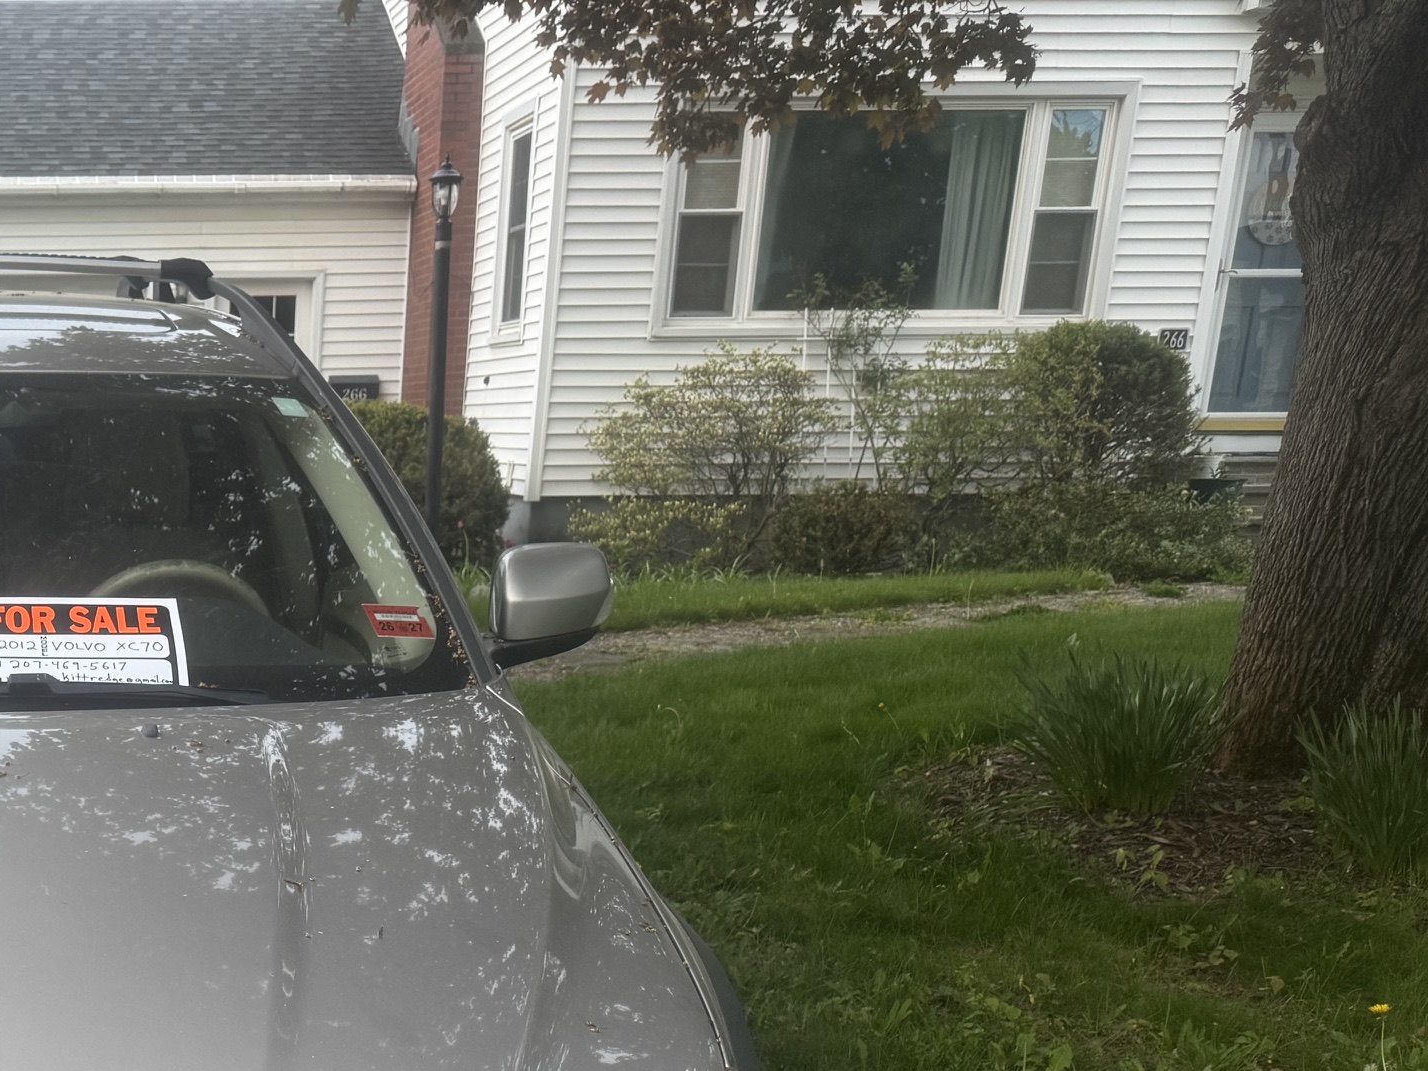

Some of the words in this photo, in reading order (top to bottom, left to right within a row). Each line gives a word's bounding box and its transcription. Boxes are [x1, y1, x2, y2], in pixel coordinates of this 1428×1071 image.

[1162, 331, 1186, 348] 266
[342, 388, 367, 401] 266
[69, 606, 161, 634] SALE
[379, 622, 395, 631] 26
[408, 623, 423, 632] 27
[51, 641, 106, 652] VOLVO
[116, 641, 164, 652] XC70
[9, 659, 128, 671] 207-469-5617
